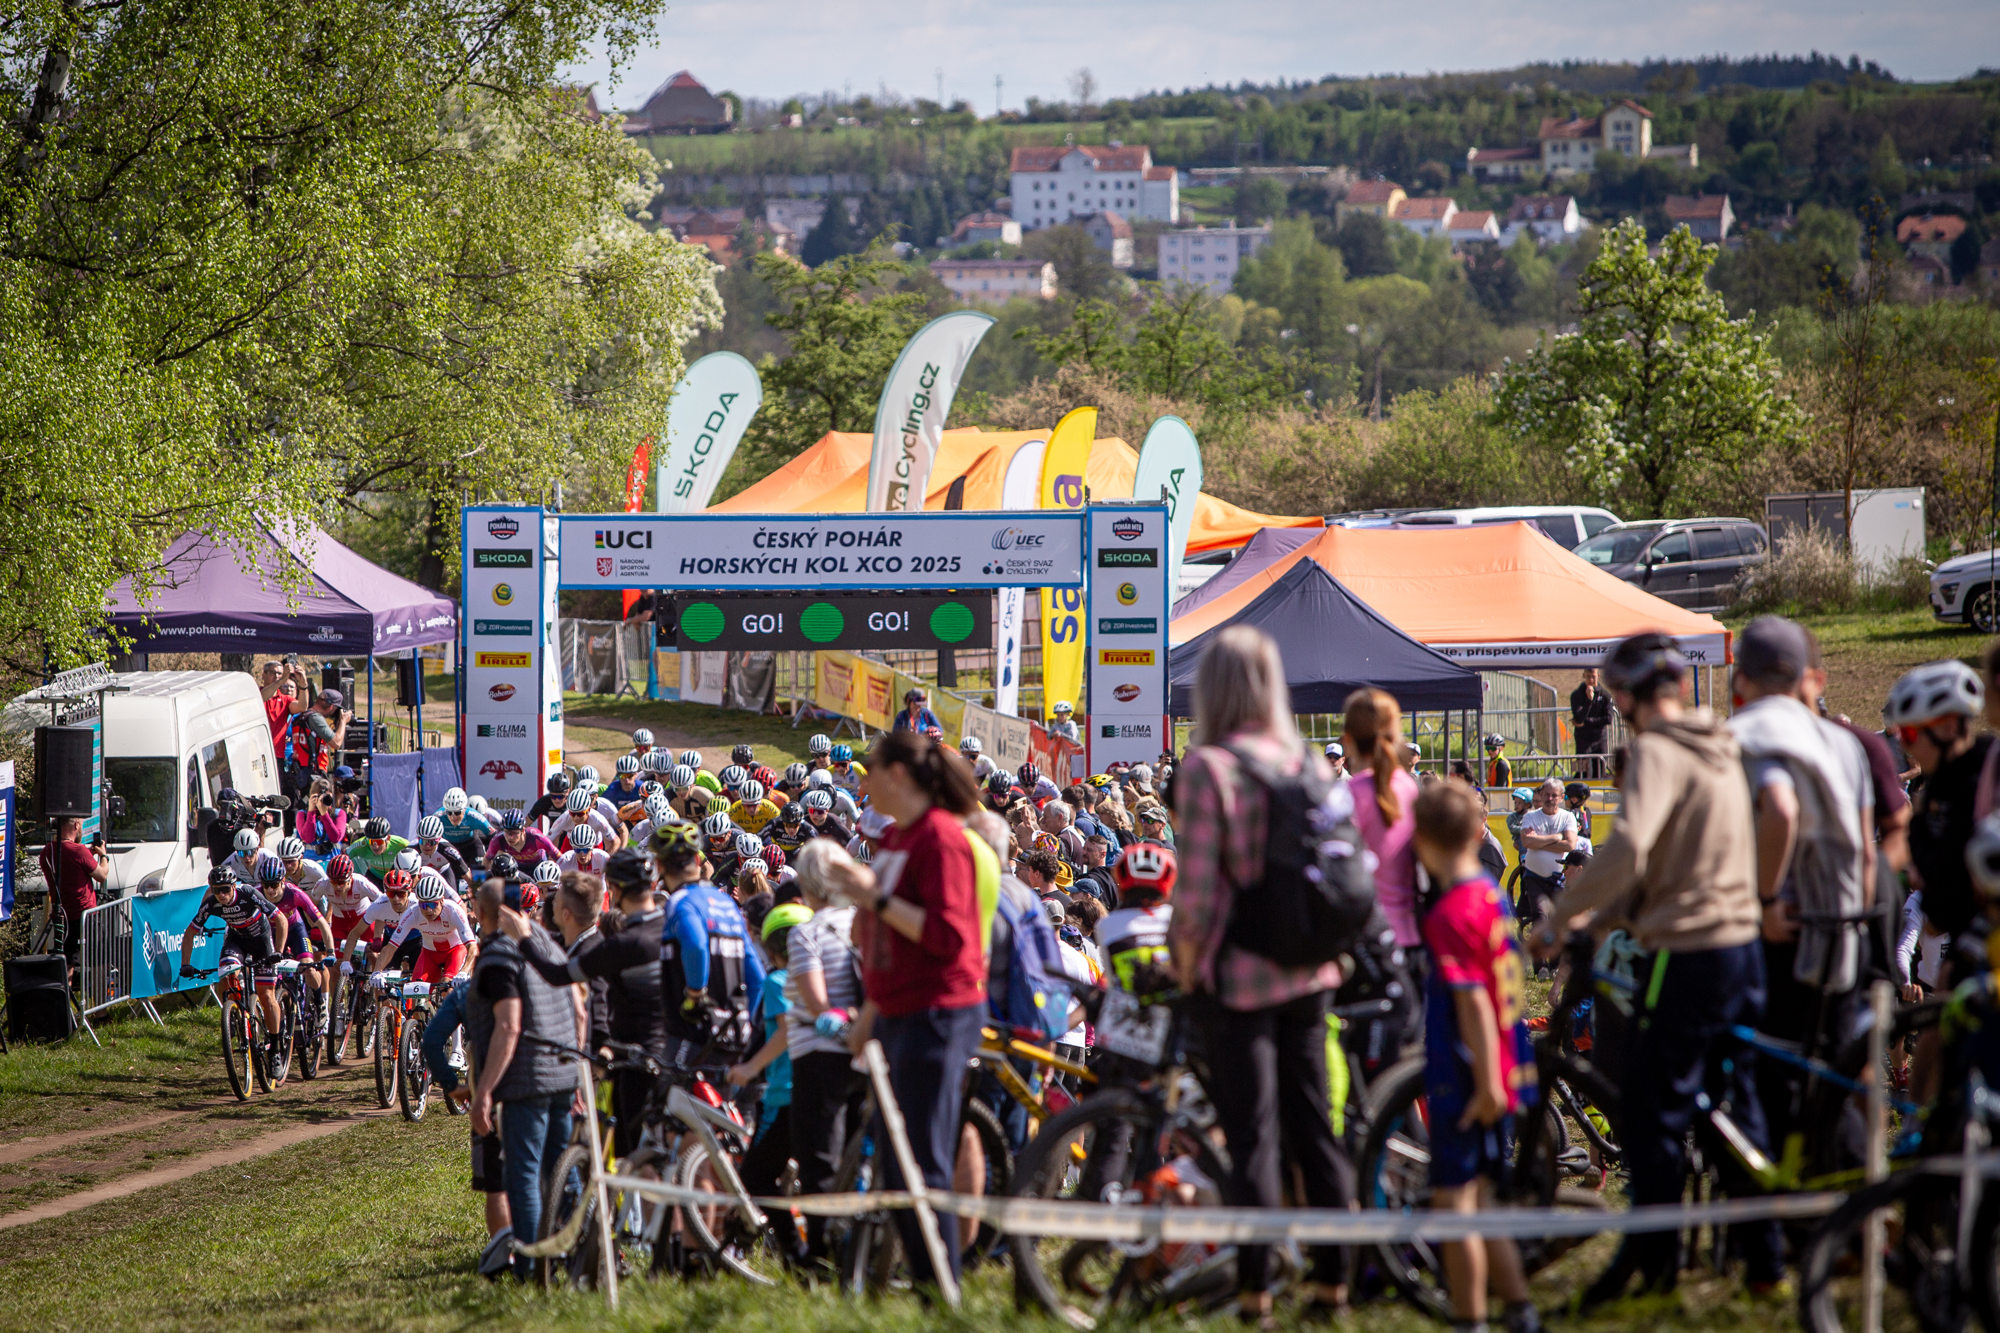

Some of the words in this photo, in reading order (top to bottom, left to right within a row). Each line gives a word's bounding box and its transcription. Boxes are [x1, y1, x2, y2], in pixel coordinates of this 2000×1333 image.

[605, 530, 652, 549] UCI
[752, 526, 818, 548] ČESKÝ
[825, 526, 902, 548] POHÁR
[1016, 534, 1045, 545] UEC
[679, 552, 797, 574] HORSKÝCH
[804, 556, 849, 574] KOL
[855, 556, 903, 573] XCO
[910, 556, 962, 573] 2025
[1033, 559, 1053, 567] SVAZ
[1006, 567, 1049, 575] CYKLISTIKY
[741, 612, 784, 634] GO!
[867, 611, 910, 632] GO!
[160, 625, 257, 637] www.poharmtb.cz
[1466, 646, 1551, 657] příspěvková
[480, 654, 527, 665] PIRELLI
[1104, 652, 1150, 663] PIRELLI
[496, 724, 527, 733] KLIMA
[1121, 724, 1152, 733] KLIMA
[413, 984, 420, 993] 6
